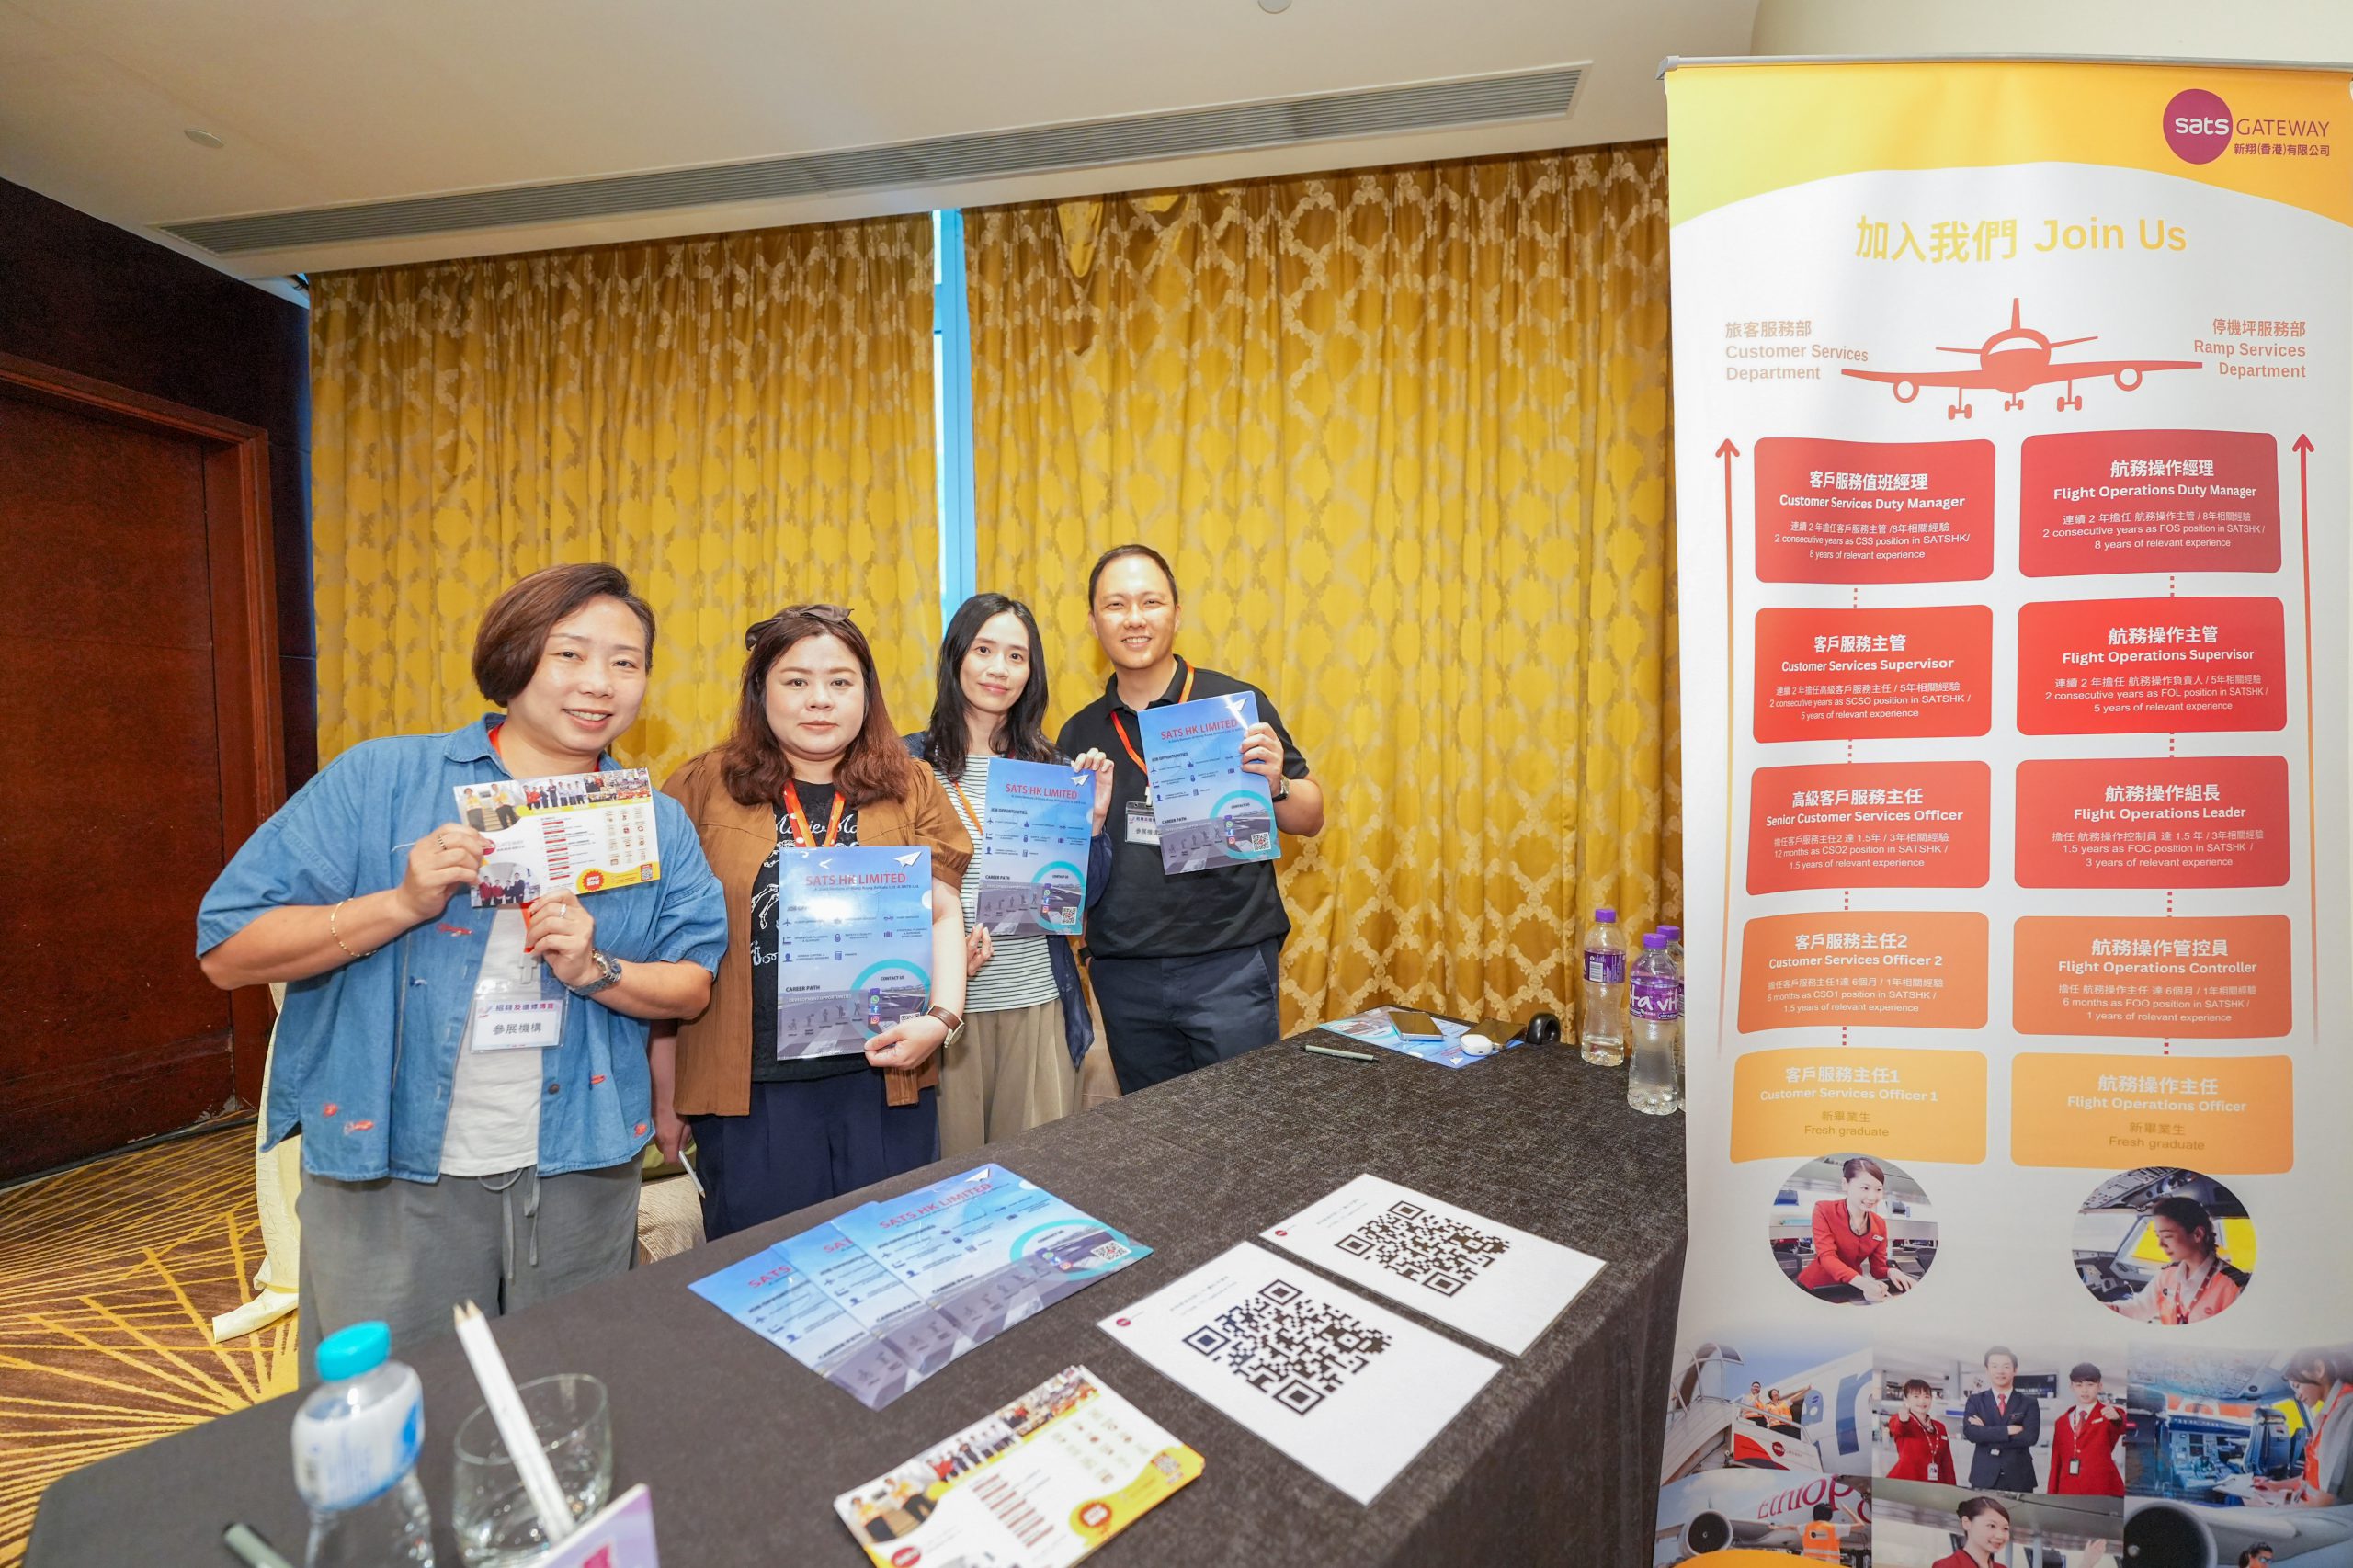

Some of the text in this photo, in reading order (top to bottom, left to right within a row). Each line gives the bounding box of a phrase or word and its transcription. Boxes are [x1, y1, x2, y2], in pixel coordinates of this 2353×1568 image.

[2175, 117, 2330, 137] sats GATEWAY
[2234, 143, 2330, 156] 新翔(香港)有限公司
[1855, 214, 2187, 263] 加入我們 Join Us
[1725, 320, 1812, 339] 旅客服務部
[2213, 318, 2306, 337] 停機坪服務部
[1726, 345, 1868, 361] Customer Services
[2194, 340, 2305, 358] Ramp Services
[1726, 367, 1820, 382] Department
[2219, 362, 2306, 379] Department
[2110, 460, 2214, 478] 航務操作經理
[1810, 471, 1928, 491] 客戶服務值班經理
[2054, 484, 2256, 501] Flight Operations Duty Manager
[1779, 494, 1965, 511] Customer Services Duty Manager
[1775, 534, 1779, 542] 2
[1782, 535, 1824, 544] consecutive
[1824, 536, 1843, 545] years
[1876, 537, 1909, 546] position
[1913, 536, 1920, 544] in
[1810, 550, 1813, 558] 8
[1815, 551, 1834, 560] years
[1876, 551, 1925, 560] experience
[1814, 634, 1906, 653] 客戶服務主管
[2109, 626, 2218, 645] 航務操作主管
[2063, 649, 2254, 665] Flight Operations Supervisor
[1782, 658, 1954, 673] Customer Services Supervisor
[2081, 678, 2087, 687] 2
[2055, 689, 2113, 699] consecutive
[2117, 690, 2143, 699] years
[2161, 688, 2180, 697] FOL
[2184, 687, 2217, 698] position
[2220, 687, 2226, 696] in
[2230, 687, 2263, 696] SATSHK
[2094, 702, 2233, 713] 5 years of relevant experience
[1161, 729, 1183, 740] SATS
[1186, 726, 1199, 735] HK
[1200, 719, 1238, 732] LIMITED
[1006, 784, 1028, 794] SATS
[1030, 787, 1041, 795] HK
[1044, 788, 1077, 799] LIMITED
[1792, 788, 1923, 808] 高級客戶服務主任
[2105, 784, 2220, 802] 航務操作組長
[1767, 810, 1963, 826] Senior Customer Services Officer
[2075, 807, 2246, 822] Flight Operations Leader
[2063, 845, 2078, 853] 1.5
[2081, 846, 2109, 855] years
[2128, 844, 2151, 852] FOC
[2154, 844, 2192, 854] position
[2196, 844, 2203, 852] in
[2207, 844, 2245, 852] SATSHK
[2086, 858, 2233, 869] 3 years of relevant experience
[806, 875, 835, 885] SATS
[859, 873, 905, 884] LIMITED
[1795, 933, 1907, 950] 客戶服務主任2
[2091, 939, 2228, 957] 航務操作管控員
[1769, 955, 1942, 969] Customer Services Officer 2
[2059, 960, 2256, 974] Flight Operations Controller
[1786, 1066, 1900, 1084] 客戶服務主任1
[2097, 1075, 2219, 1095] 航務操作主任
[1760, 1088, 1938, 1101] Customer Services Officer 1
[2067, 1096, 2247, 1112] Flight Operations Officer
[1805, 1125, 1889, 1137] Fresh graduate
[2109, 1136, 2205, 1151] Fresh graduate
[880, 1183, 992, 1229] SATS HK LIMITED
[824, 1237, 853, 1253] SAT
[748, 1266, 791, 1288] SATS
